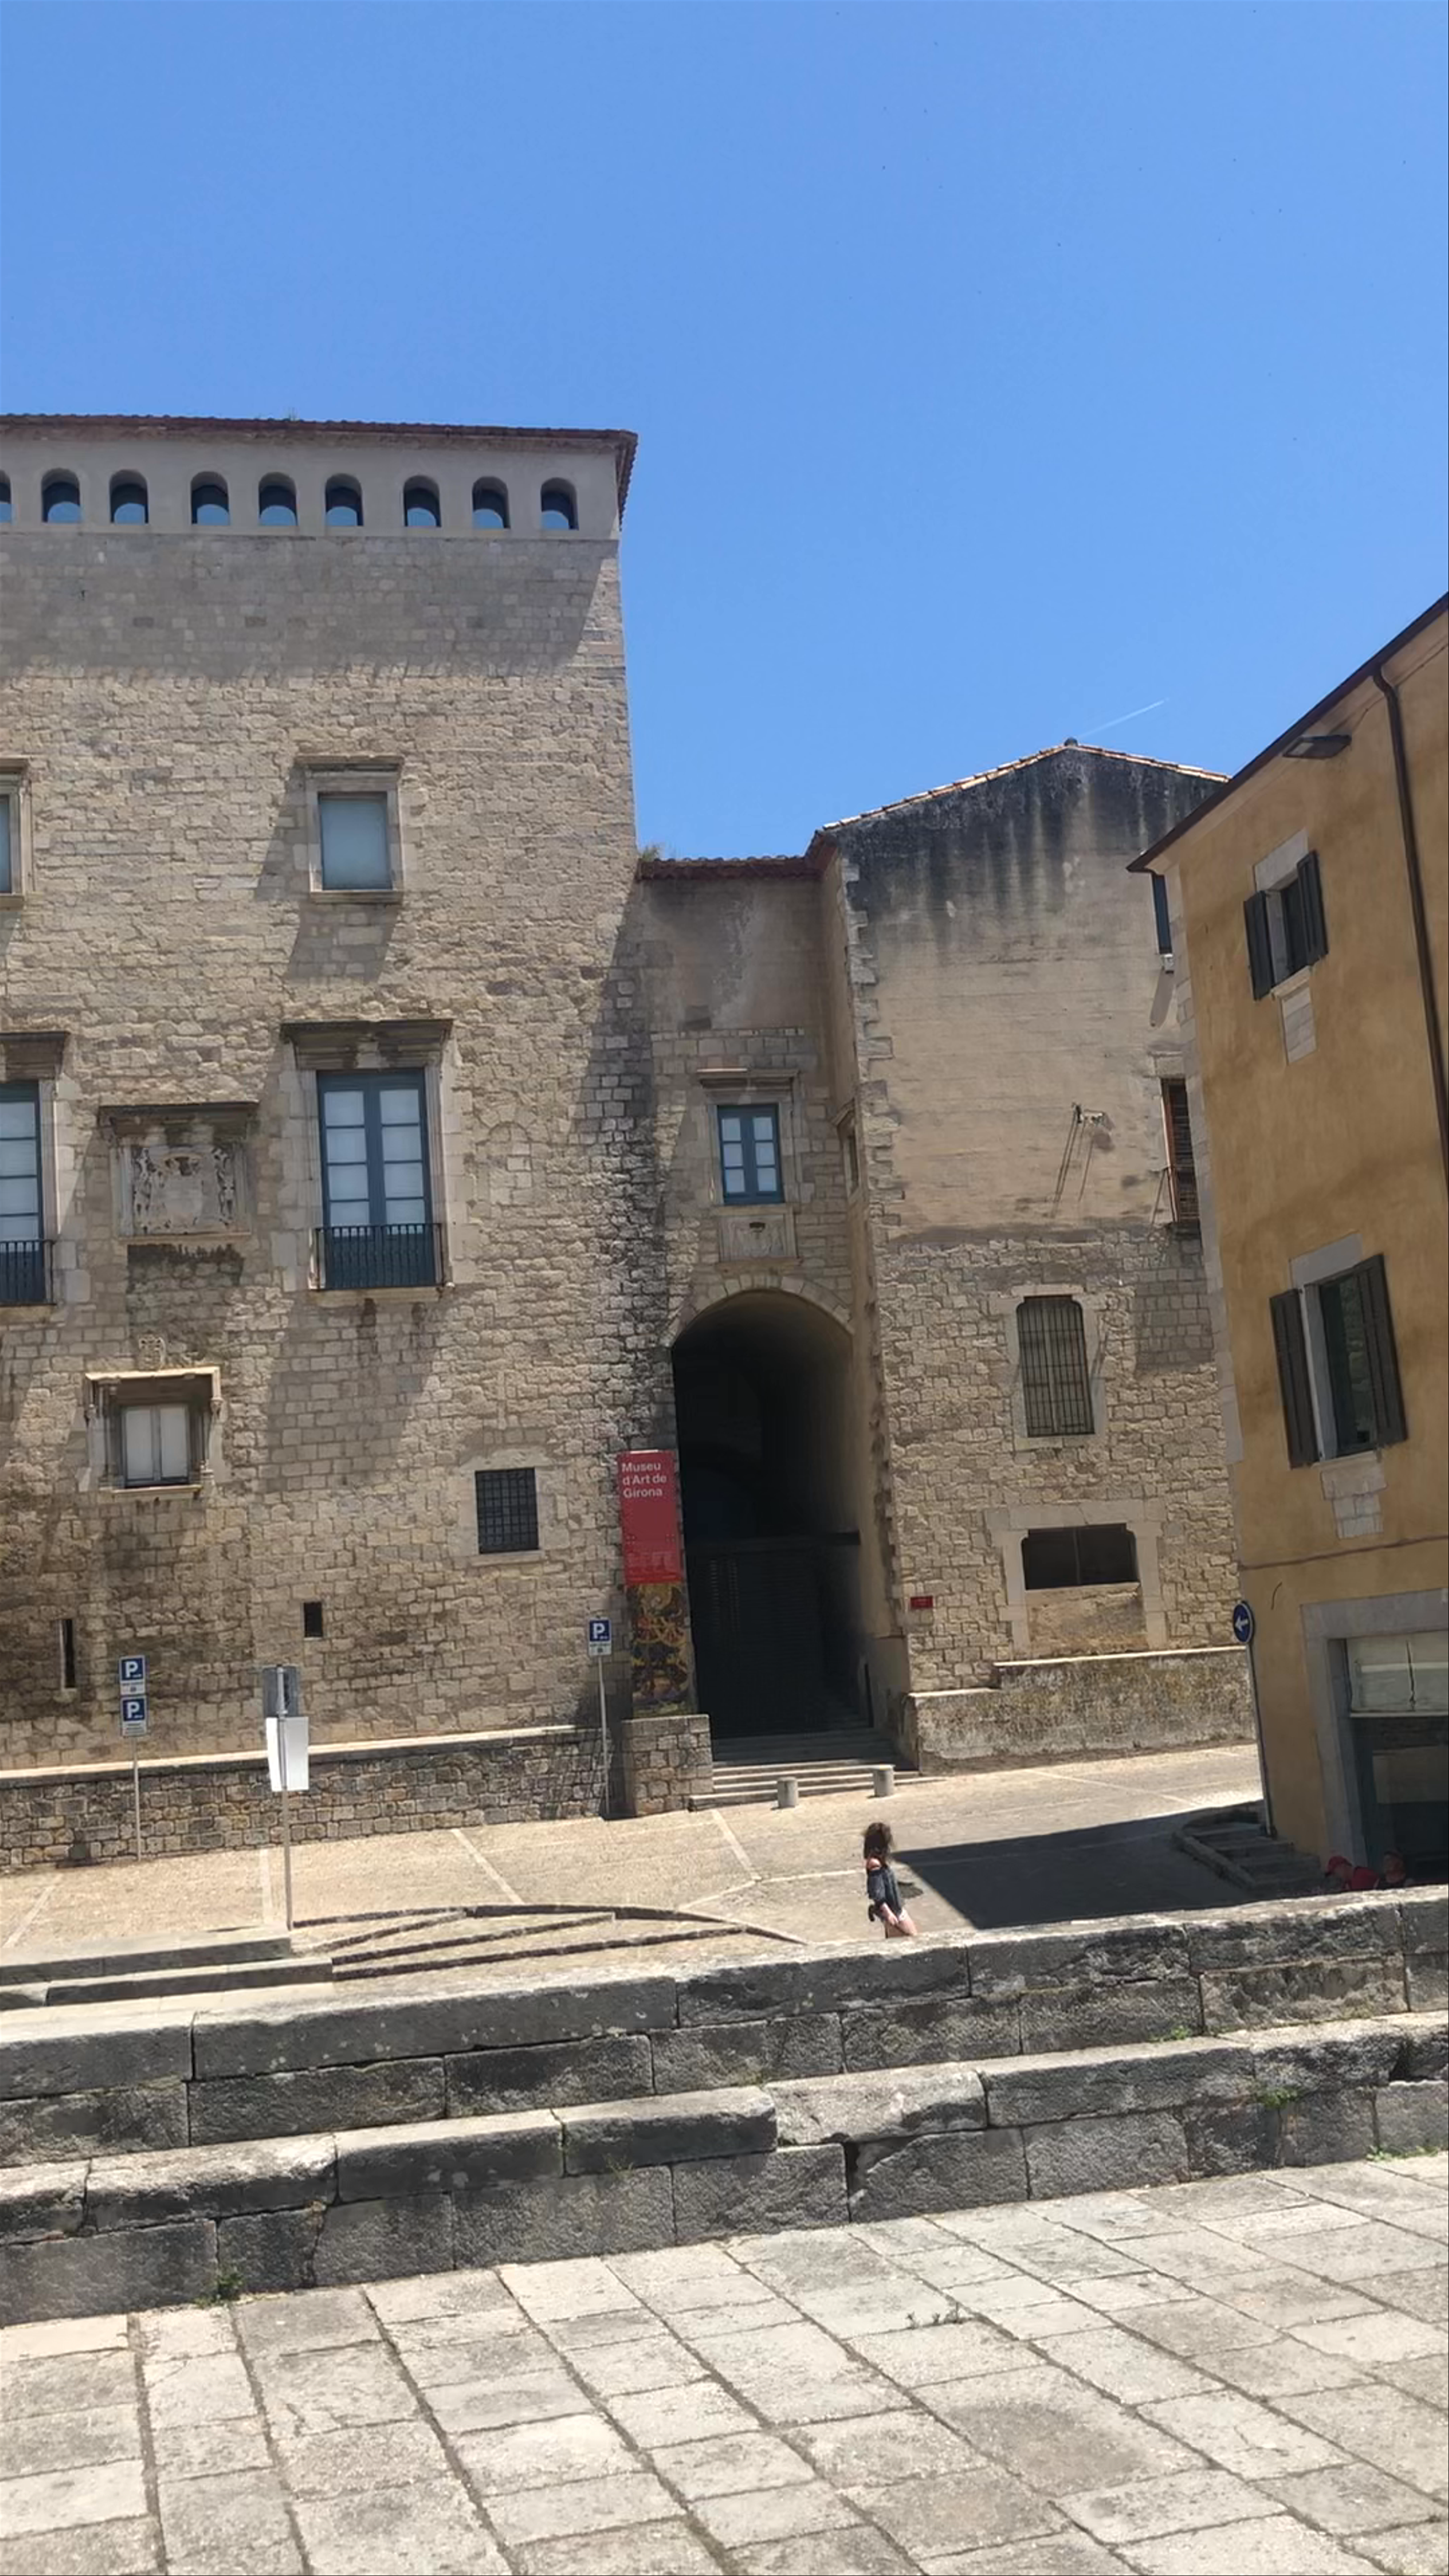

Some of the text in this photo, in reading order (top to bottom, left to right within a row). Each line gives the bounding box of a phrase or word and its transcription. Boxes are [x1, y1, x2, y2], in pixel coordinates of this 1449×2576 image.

[622, 1462, 661, 1472] Museu
[652, 1473, 667, 1483] de
[623, 1487, 663, 1499] Girona
[593, 1623, 605, 1639] P
[126, 1661, 138, 1678] P
[127, 1701, 140, 1719] P
